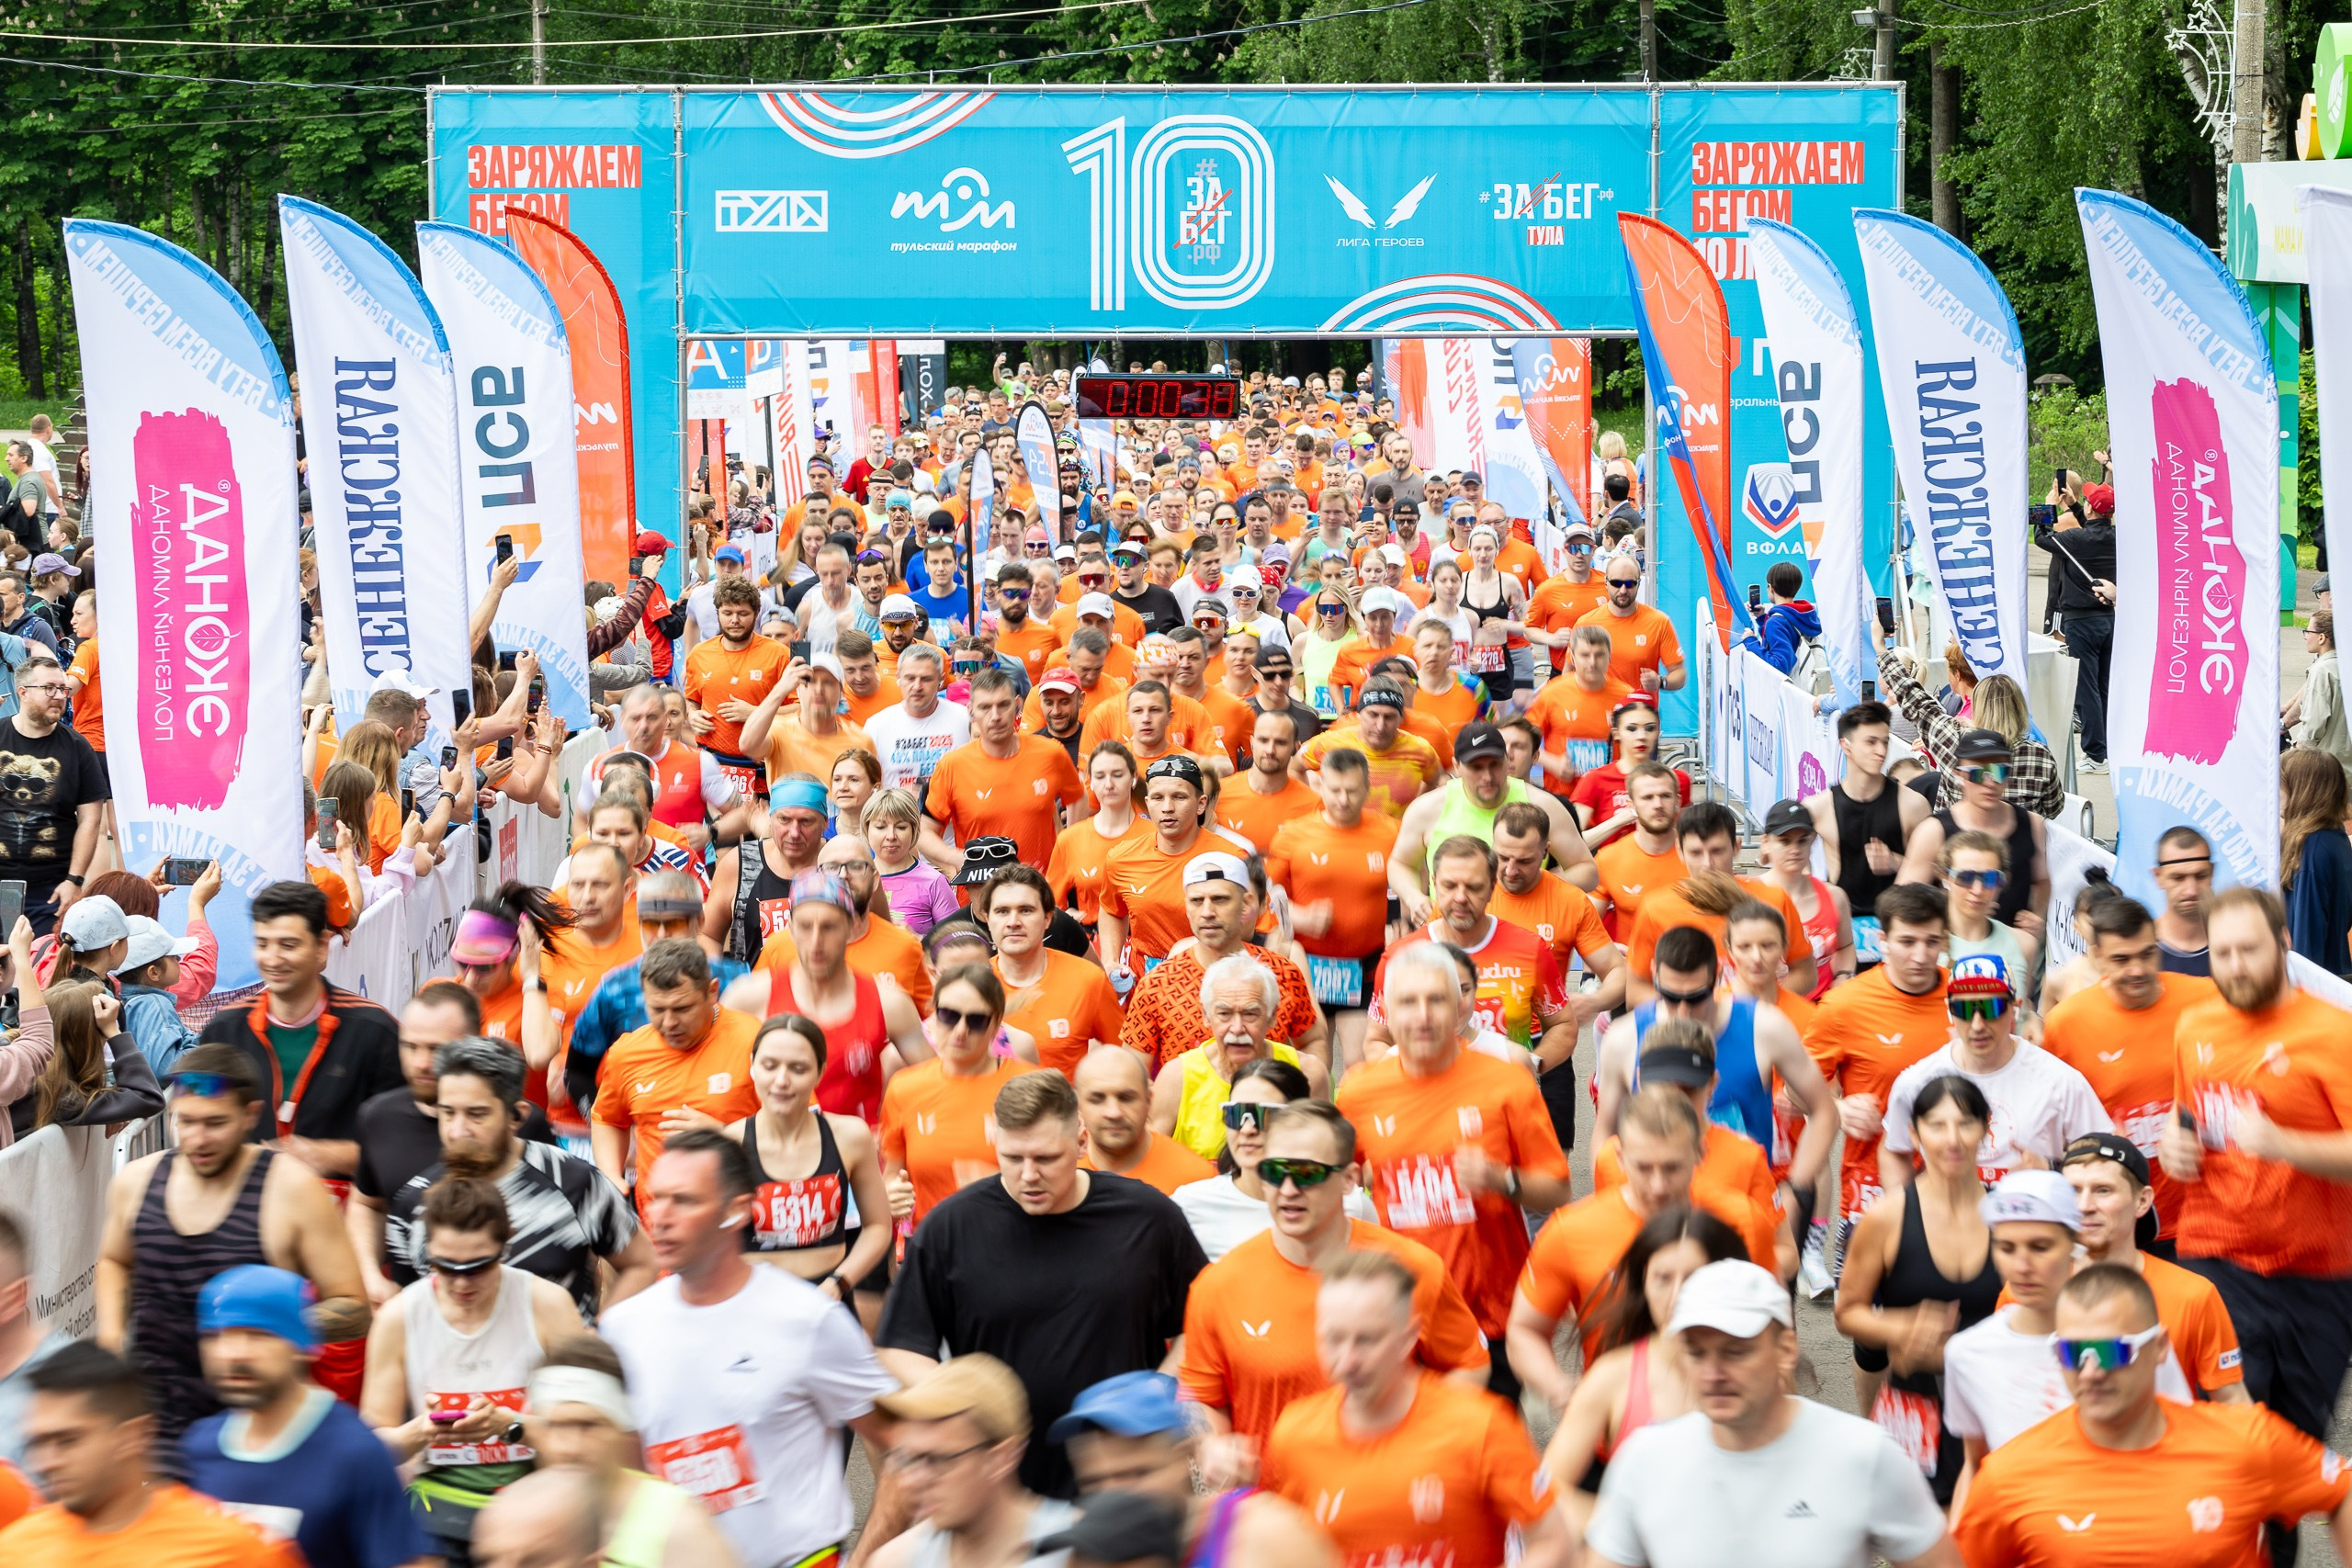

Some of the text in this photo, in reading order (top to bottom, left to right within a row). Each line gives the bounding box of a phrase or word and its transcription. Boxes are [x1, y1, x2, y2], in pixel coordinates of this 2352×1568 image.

[468, 145, 641, 188] ЗАРЯЖАЕМ
[1692, 141, 1864, 185] ЗАРЯЖАЕМ
[1336, 238, 1425, 247] ЛИГА ГЕРОЕВ
[1527, 226, 1564, 245] ТУЛА
[890, 240, 1017, 254] тульский марафон
[967, 868, 999, 882] NIK
[771, 1191, 825, 1231] 5314
